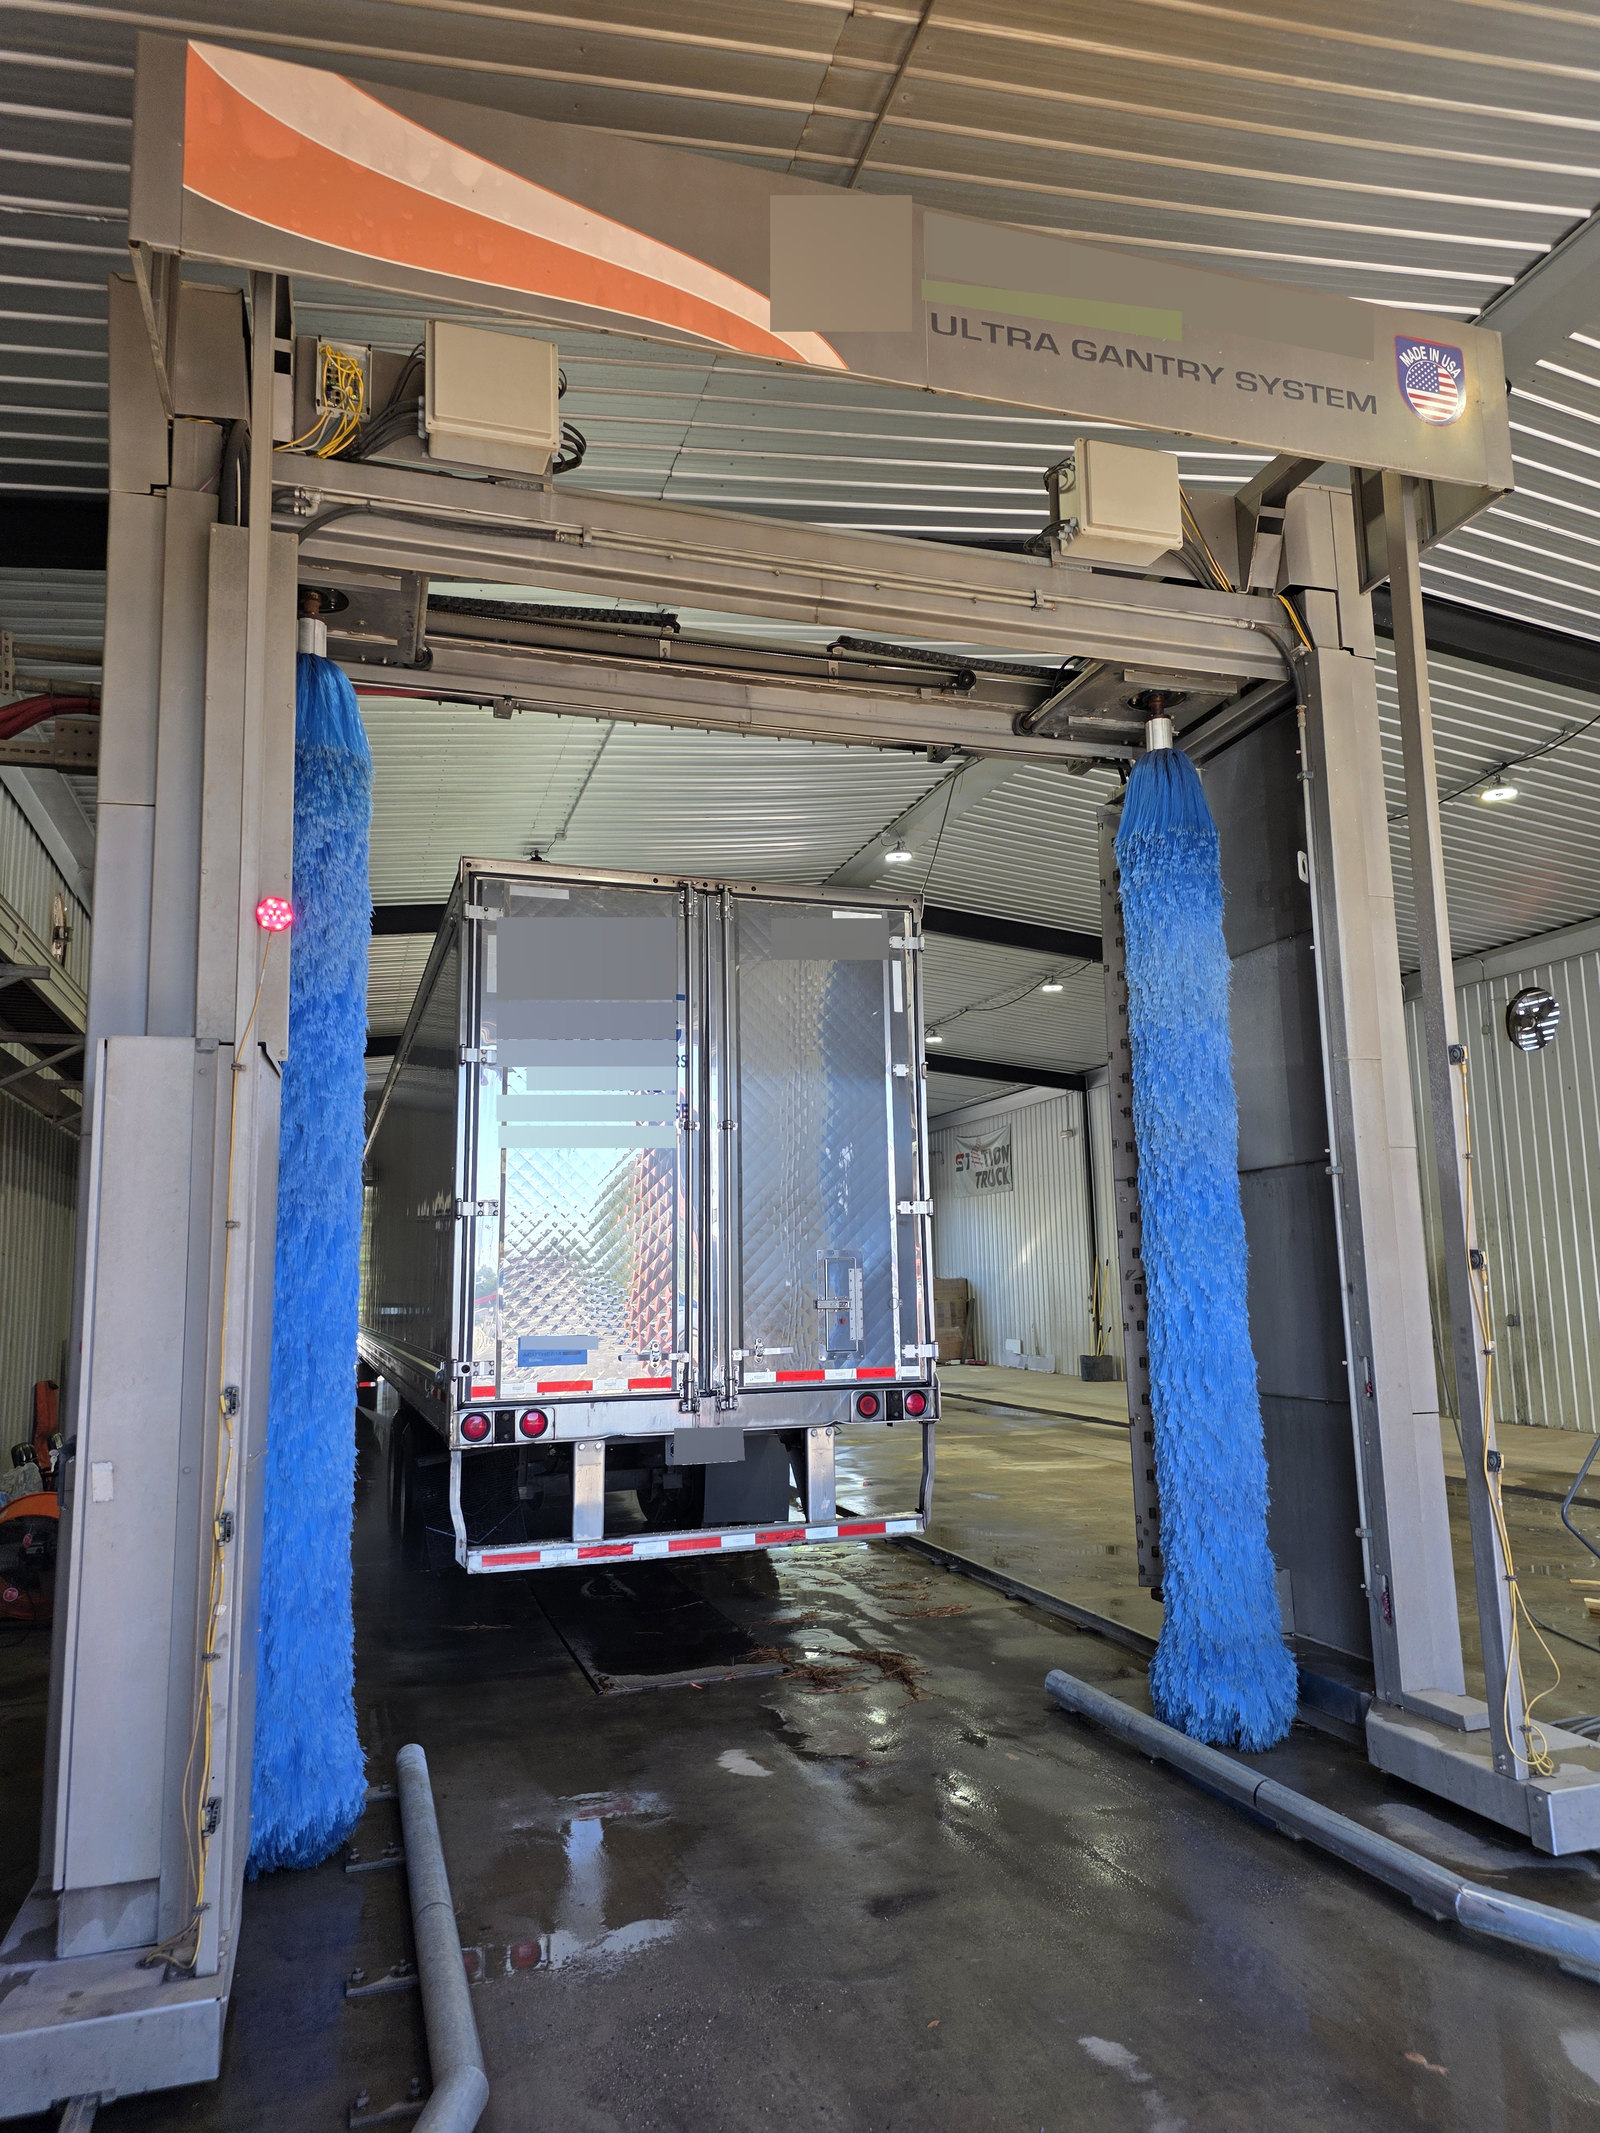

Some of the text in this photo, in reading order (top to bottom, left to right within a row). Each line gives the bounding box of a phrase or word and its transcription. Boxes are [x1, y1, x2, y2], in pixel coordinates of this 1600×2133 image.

[931, 312, 1377, 414] ULTRA GANTRY SYSTEM
[1399, 346, 1461, 378] MADE IN USA
[975, 1166, 1010, 1189] TRUCK
